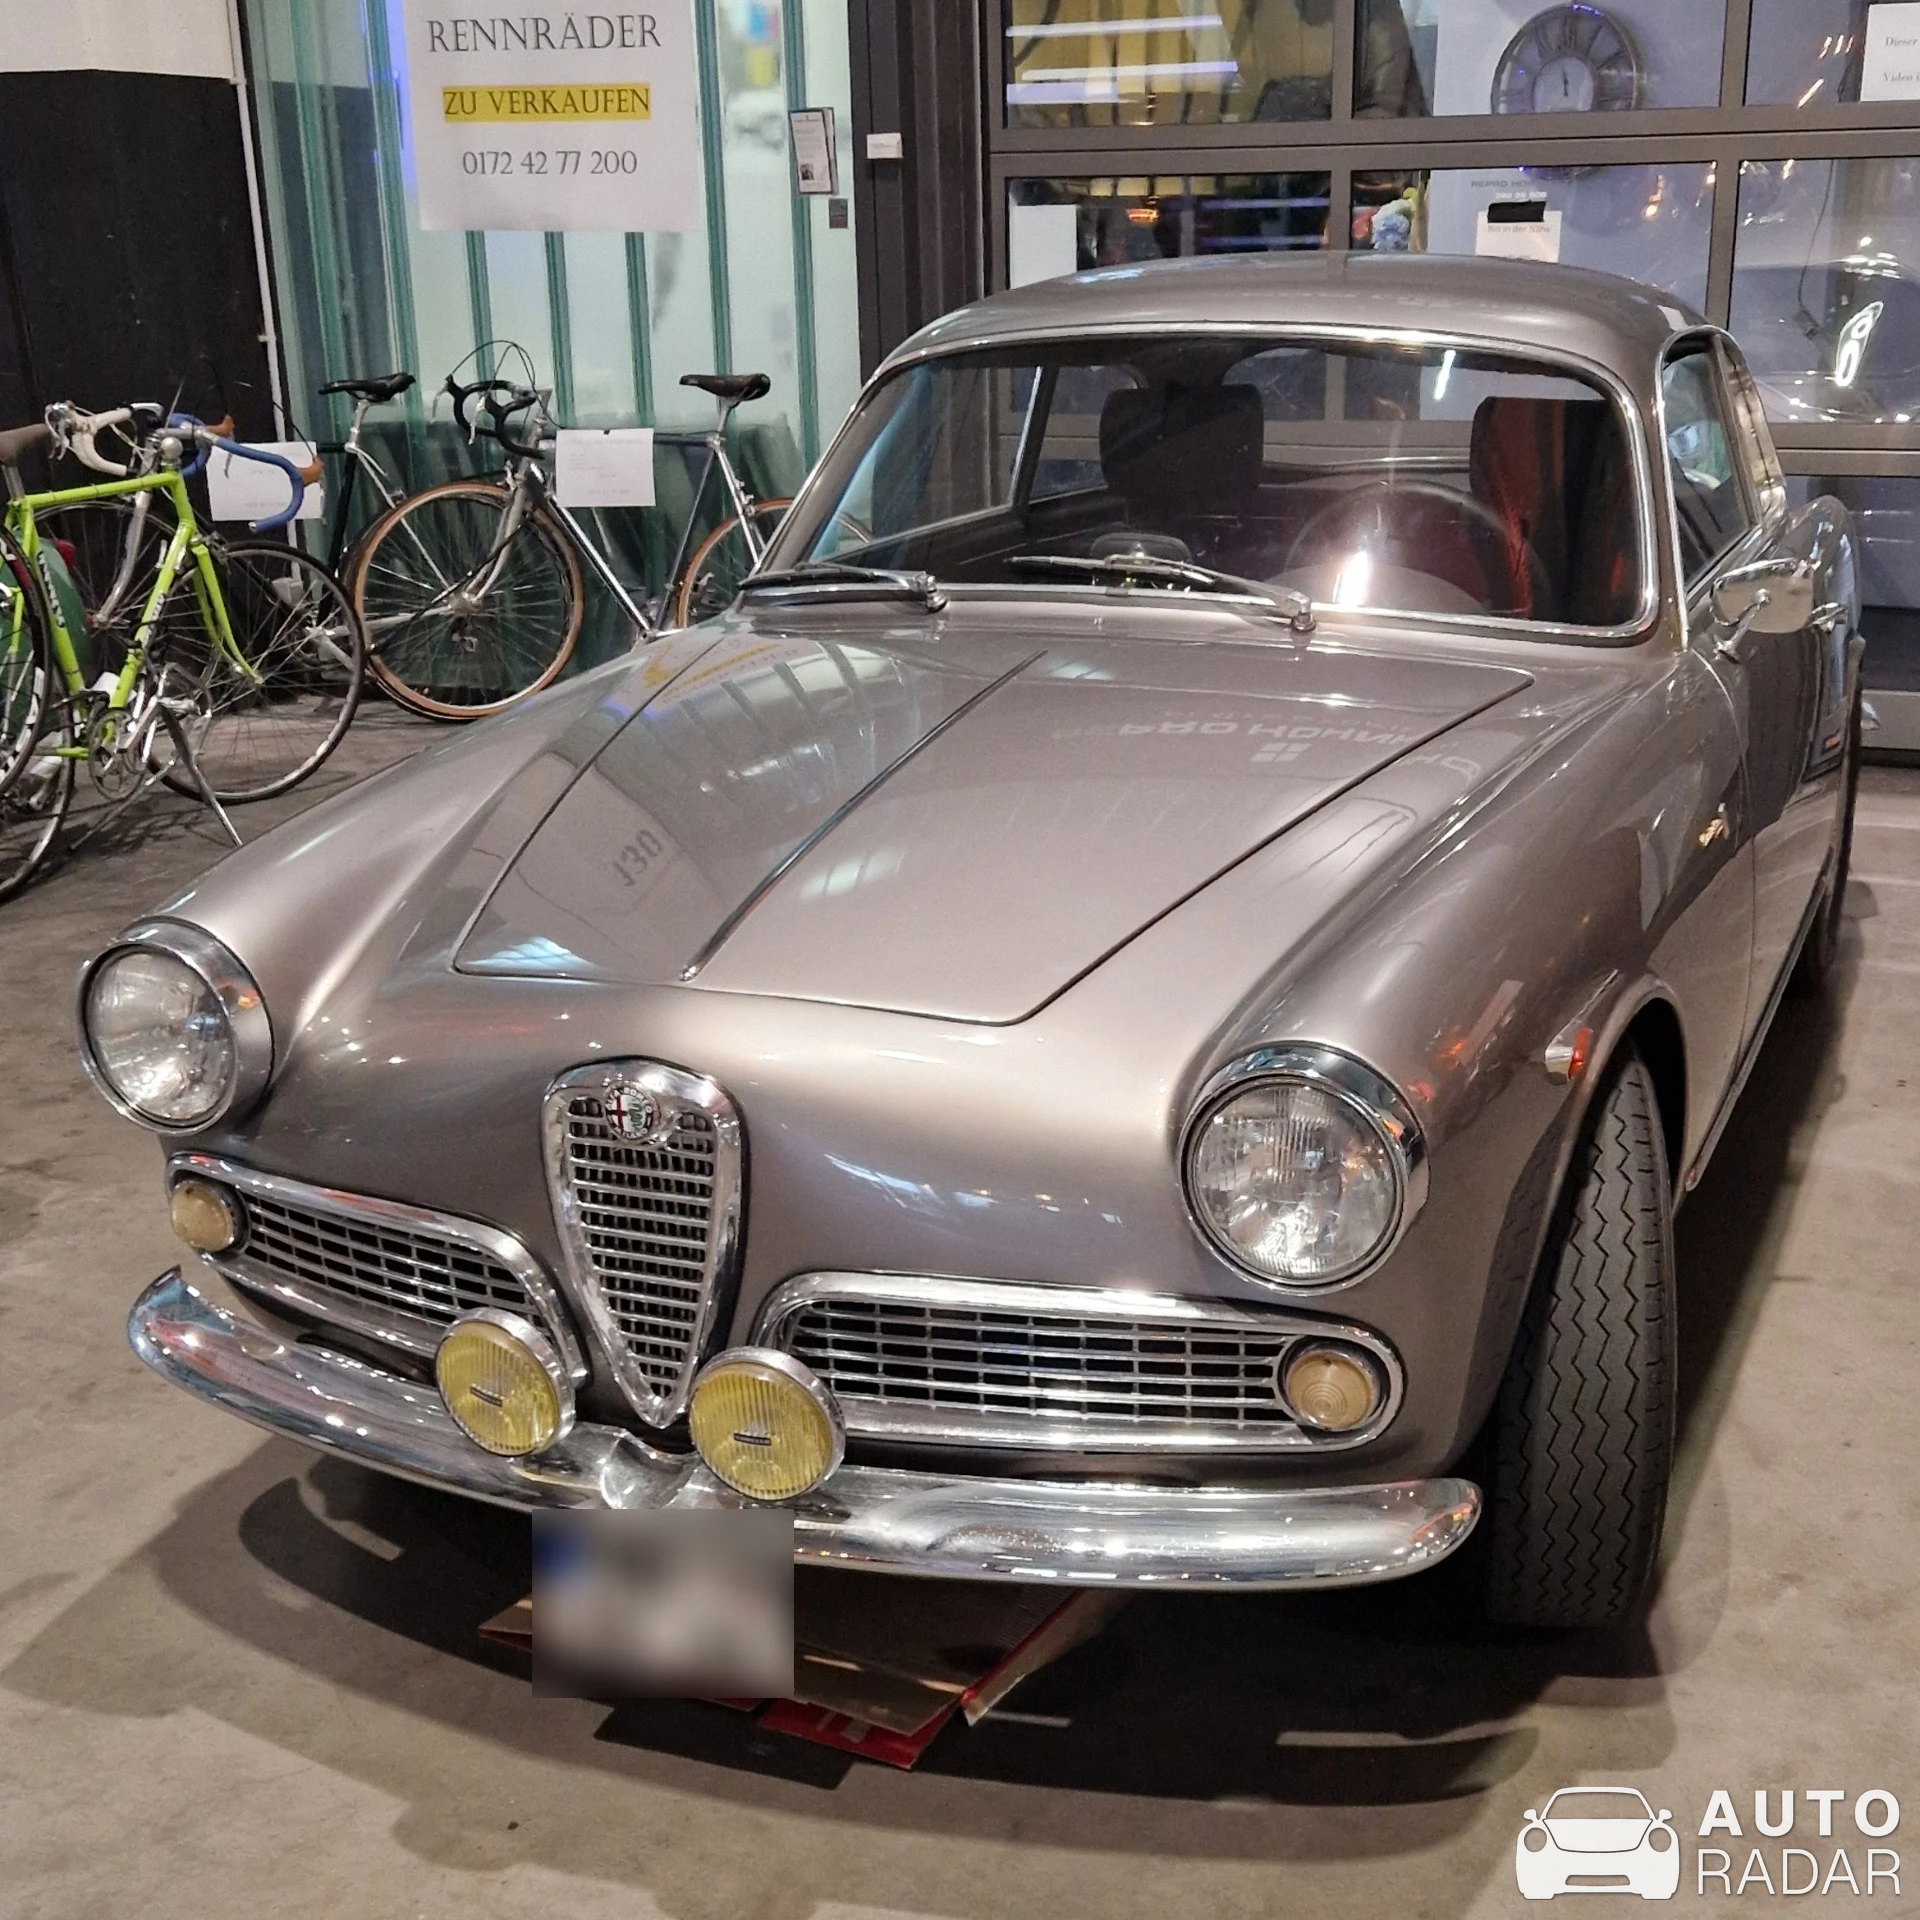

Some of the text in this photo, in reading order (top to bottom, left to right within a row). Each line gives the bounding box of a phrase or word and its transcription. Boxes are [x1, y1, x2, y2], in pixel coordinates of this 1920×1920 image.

[427, 13, 662, 52] RENNRÄDER
[1885, 36, 1918, 46] Dieser
[1884, 72, 1913, 82] Video
[444, 89, 650, 115] ZU VERKAUFEN
[463, 150, 638, 175] 0172 42 77 200
